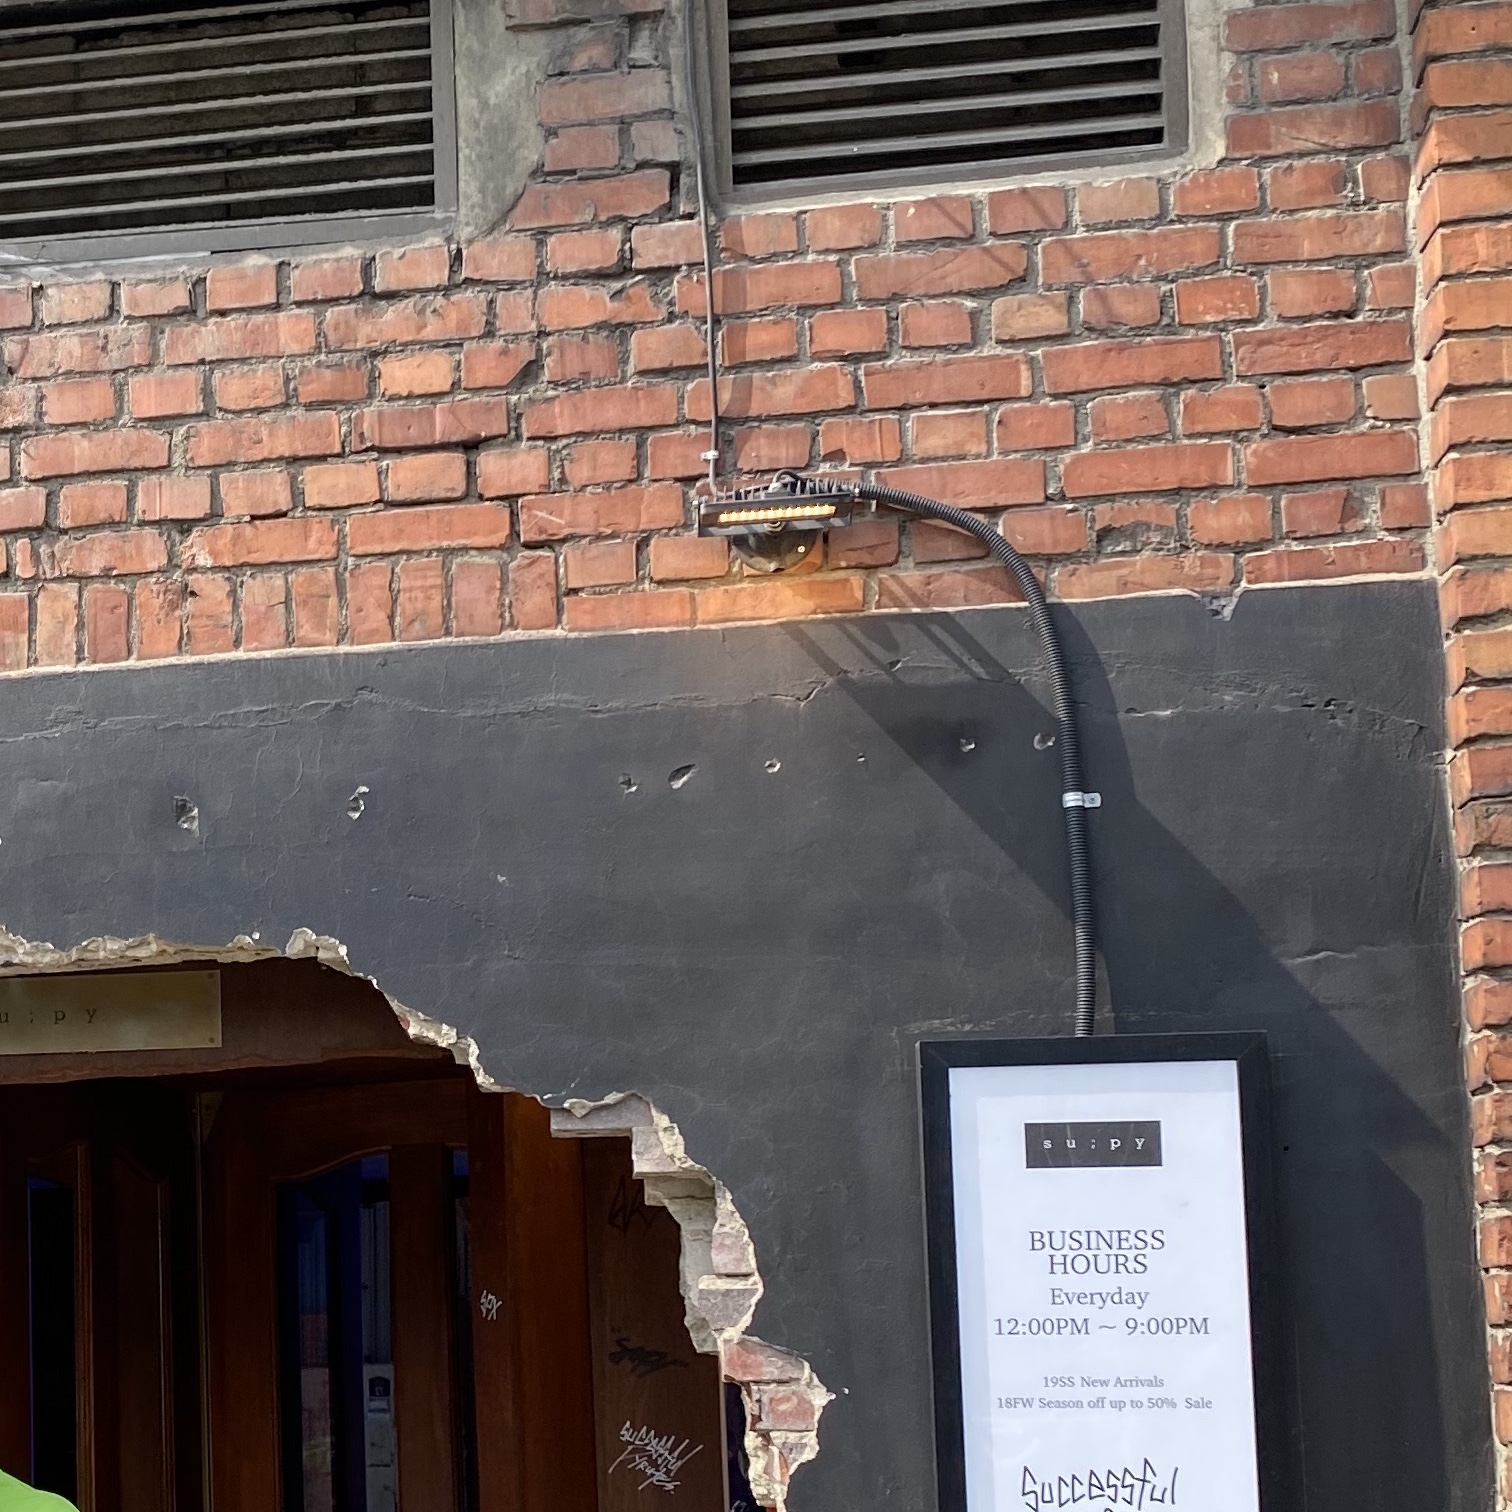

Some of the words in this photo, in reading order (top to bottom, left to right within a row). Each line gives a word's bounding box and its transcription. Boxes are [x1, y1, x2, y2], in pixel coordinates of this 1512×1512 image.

[1029, 1229, 1166, 1251] BUSINESS
[1048, 1253, 1148, 1275] HOURS
[1049, 1286, 1150, 1309] Everyday
[994, 1317, 1090, 1336] 12:00PM
[1125, 1317, 1210, 1335] 9:00PM
[1043, 1376, 1076, 1388] 19SS
[1080, 1376, 1111, 1388] New
[1113, 1375, 1165, 1388] Arrivals
[997, 1397, 1034, 1409] 18FW
[1038, 1397, 1084, 1409] Season
[1087, 1396, 1106, 1409] off
[1109, 1400, 1126, 1412] up
[1130, 1398, 1144, 1409] to
[1147, 1397, 1178, 1409] 50%
[1184, 1397, 1213, 1409] Sale
